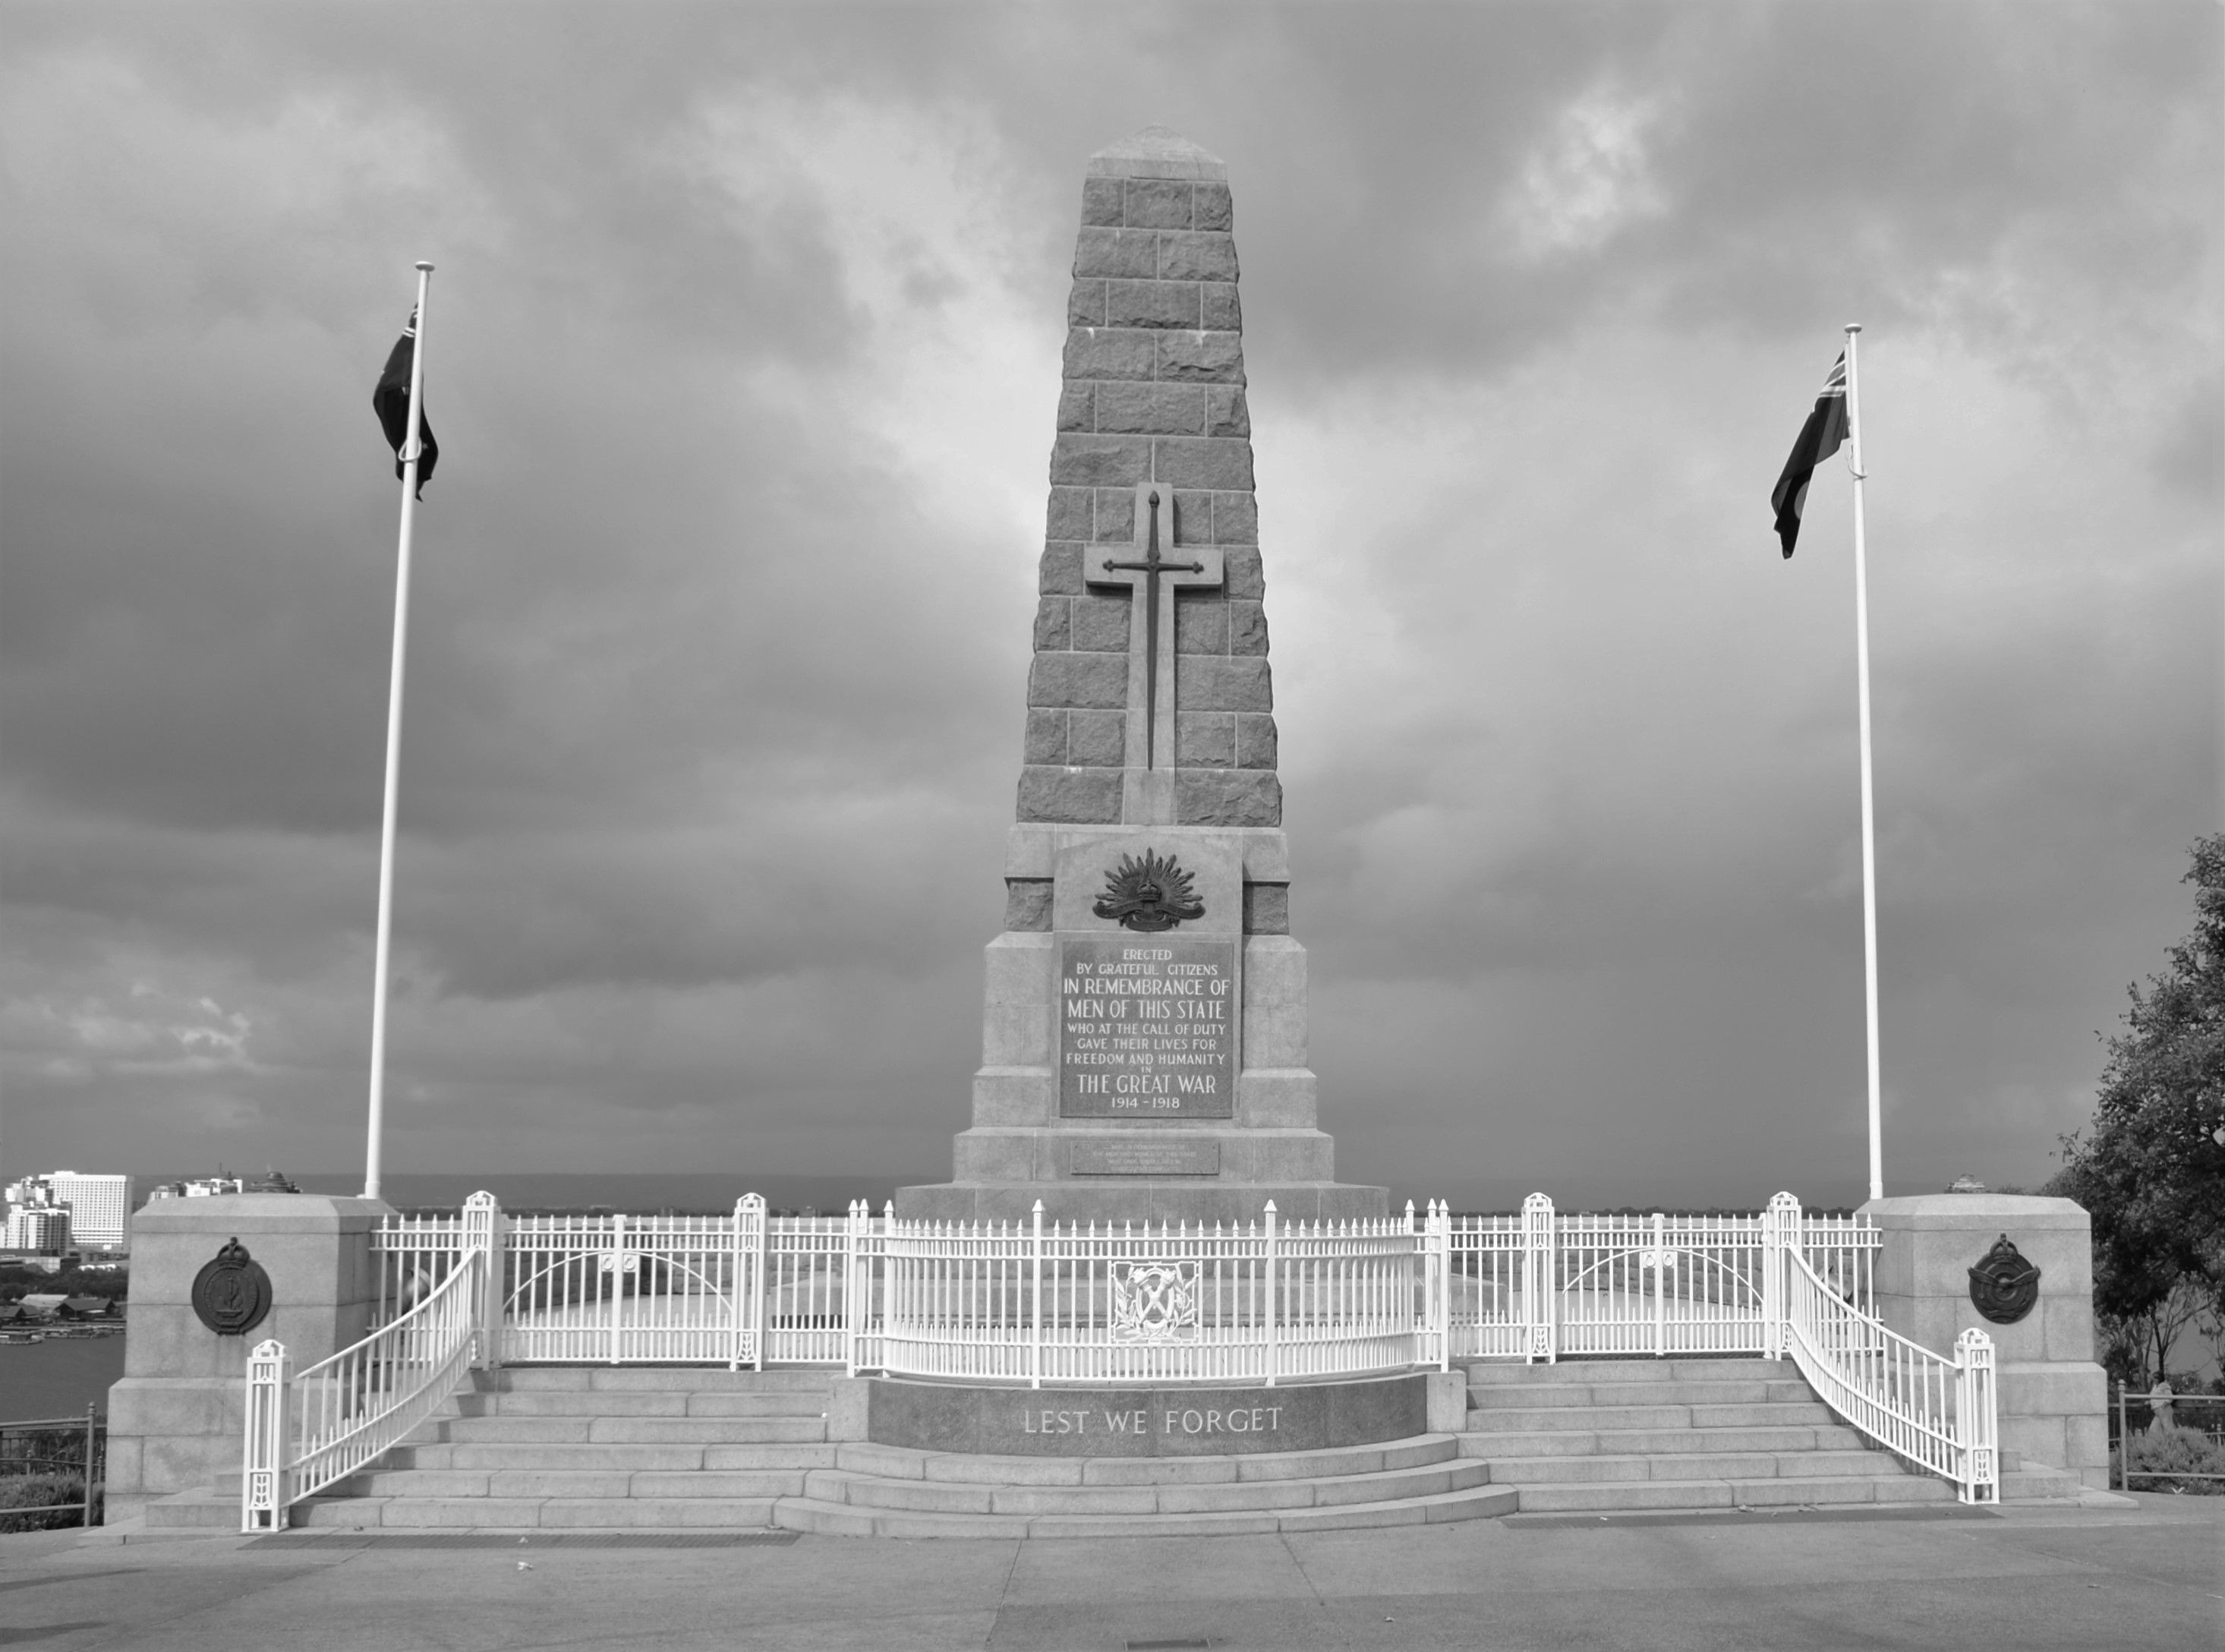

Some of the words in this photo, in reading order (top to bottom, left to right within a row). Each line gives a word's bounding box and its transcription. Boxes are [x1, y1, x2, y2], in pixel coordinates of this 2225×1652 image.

[1124, 949, 1172, 960] ERECTED
[1076, 963, 1092, 974] BY
[1098, 963, 1158, 976] GRATEFUL
[1168, 964, 1218, 976] CITIZENS
[1064, 978, 1079, 994] IN
[1085, 979, 1204, 995] REMEMBRANCE
[1211, 979, 1231, 995] OF
[1068, 999, 1103, 1018] MEN
[1110, 1000, 1130, 1018] OF
[1137, 1001, 1171, 1019] THIS
[1177, 1001, 1225, 1019] STATE
[1067, 1023, 1094, 1034] WHO
[1098, 1023, 1111, 1034] AT
[1117, 1023, 1137, 1034] THE
[1142, 1024, 1171, 1035] CALL
[1175, 1024, 1190, 1035] OF
[1193, 1024, 1226, 1035] DUTY
[1077, 1038, 1108, 1049] GAVE
[1114, 1039, 1149, 1050] THEIR
[1155, 1039, 1187, 1050] LIVES
[1193, 1039, 1216, 1050] FOR
[1067, 1053, 1124, 1064] FREEDOM
[1130, 1053, 1153, 1064] AND
[1159, 1054, 1225, 1064] HUMANITY
[1077, 1074, 1110, 1093] THE
[1117, 1075, 1171, 1093] GREAT
[1178, 1075, 1215, 1093] WAR
[1112, 1097, 1137, 1108] 1914
[1153, 1098, 1180, 1108] 1918
[1025, 1411, 1089, 1433] LEST
[1105, 1411, 1146, 1433] WE
[1165, 1408, 1283, 1433] FORGET
